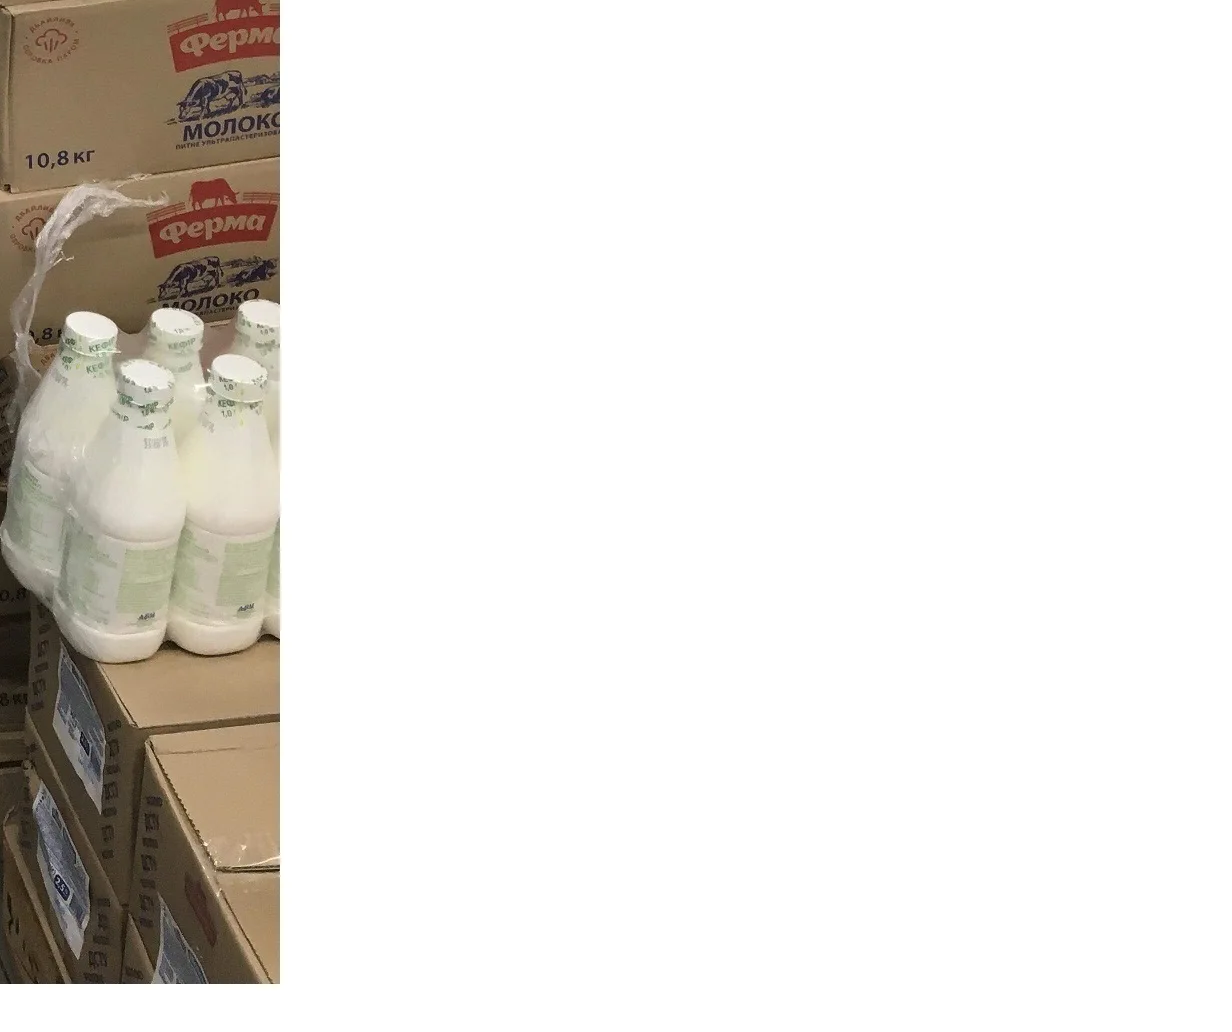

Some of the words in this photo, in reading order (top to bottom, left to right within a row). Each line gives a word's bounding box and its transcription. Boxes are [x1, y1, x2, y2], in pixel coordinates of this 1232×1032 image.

[25, 151, 70, 170] 10,8
[74, 150, 96, 164] кг
[159, 214, 267, 244] Ферма
